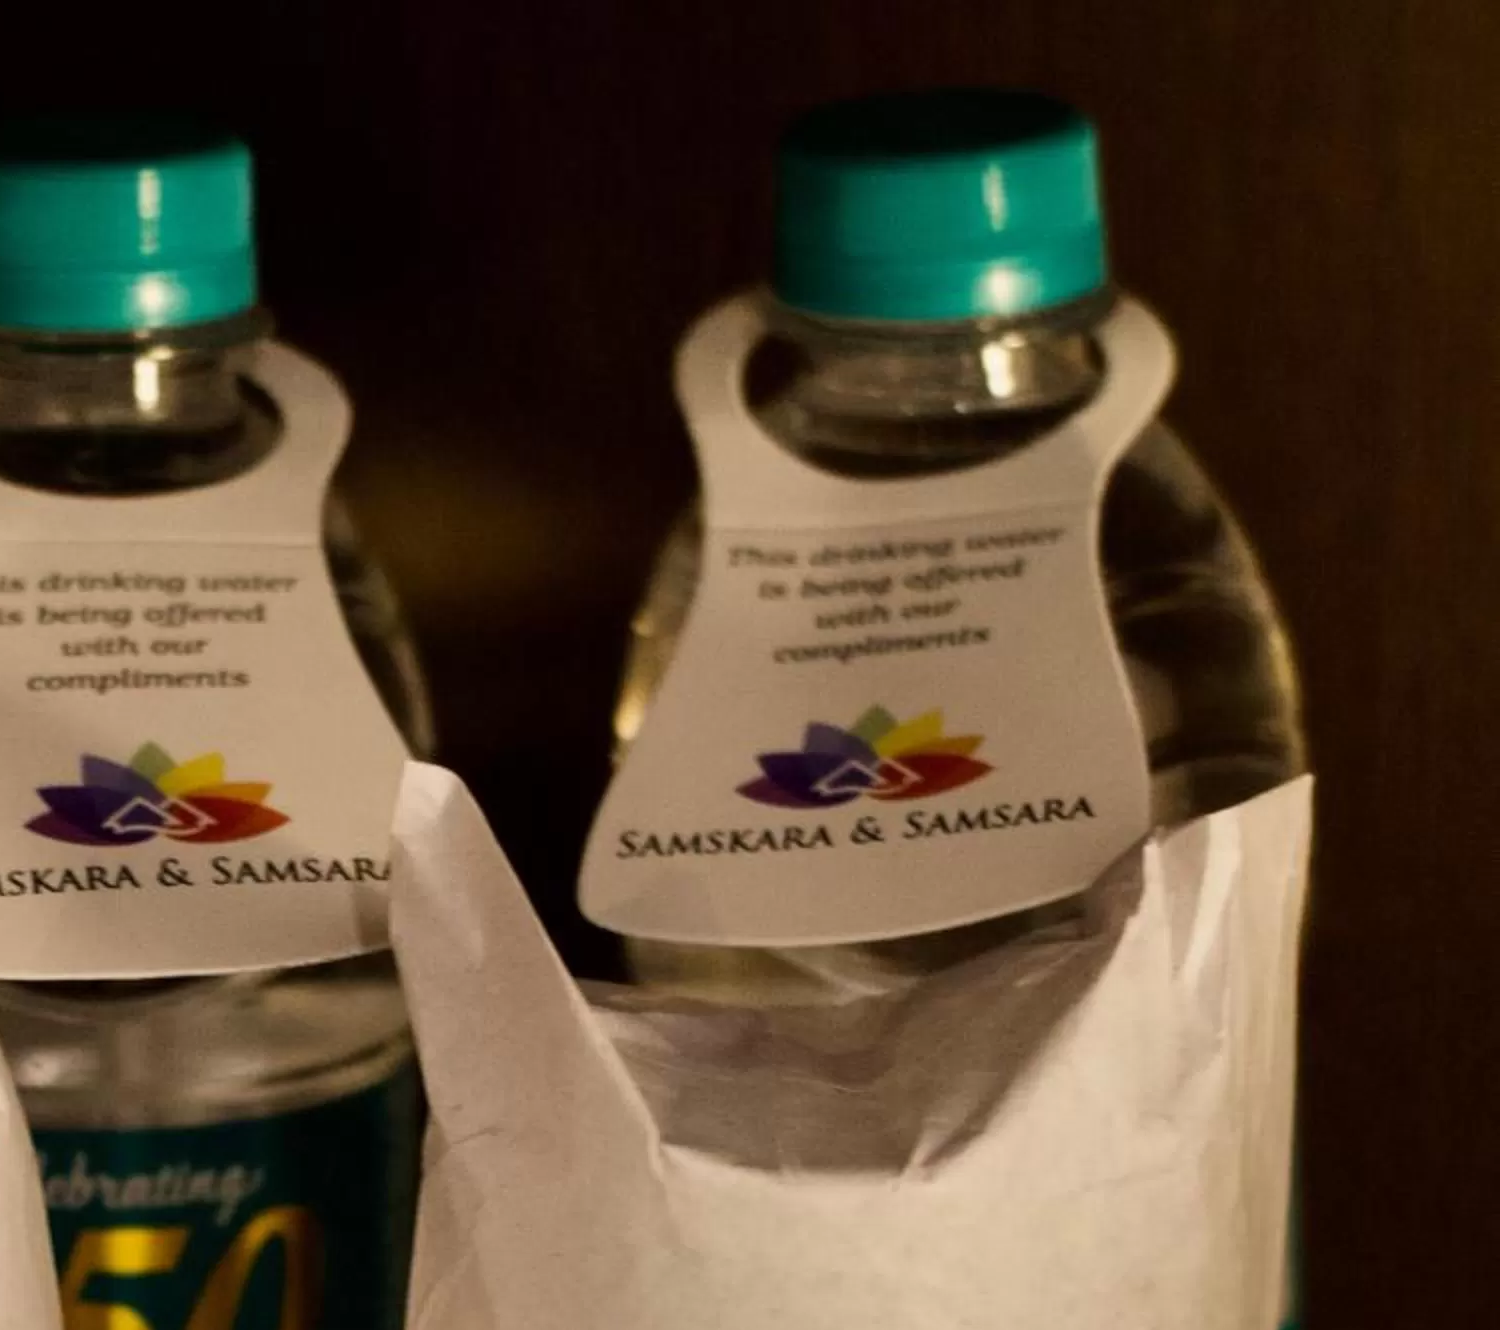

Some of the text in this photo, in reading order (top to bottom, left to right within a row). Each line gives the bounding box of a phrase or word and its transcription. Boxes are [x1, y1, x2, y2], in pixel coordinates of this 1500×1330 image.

[38, 571, 187, 600] drinking
[199, 573, 298, 594] water
[758, 557, 1026, 600] is being offered
[36, 605, 133, 631] being
[143, 604, 266, 629] offered
[815, 600, 960, 629] with our
[61, 635, 210, 658] with our
[772, 627, 991, 665] compliments
[26, 668, 251, 695] compliments
[615, 796, 1098, 859] SAMSKARA & SAMSARA
[156, 858, 194, 888] &
